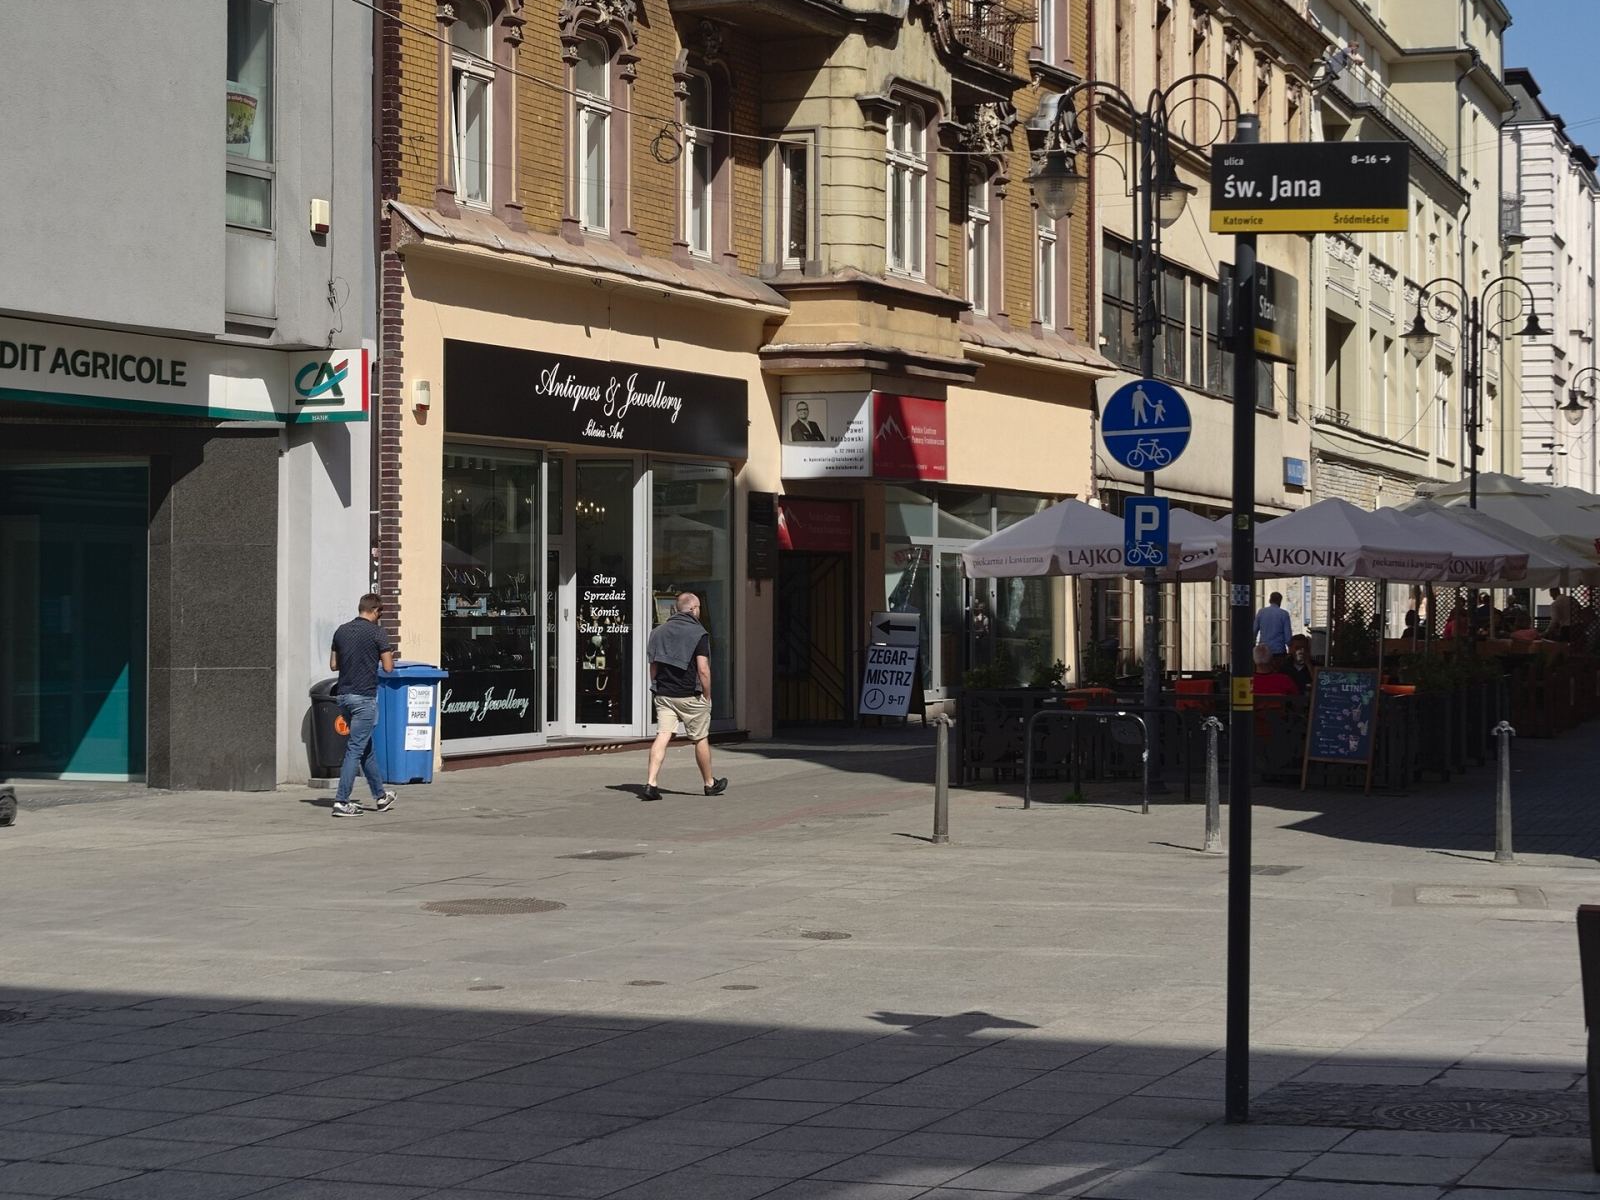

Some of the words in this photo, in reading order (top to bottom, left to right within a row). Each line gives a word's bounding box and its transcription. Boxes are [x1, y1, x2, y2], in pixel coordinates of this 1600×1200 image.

[1224, 156, 1244, 166] ulica
[1224, 174, 1263, 198] św.
[1270, 175, 1322, 201] Jana
[1223, 216, 1263, 225] Katowice
[1333, 212, 1389, 225] Śródmieście
[49, 347, 188, 387] AGRICOLE
[535, 362, 600, 412] Antiques
[604, 376, 621, 417] &
[617, 372, 683, 424] Jewellery
[582, 418, 606, 438] Silesia
[607, 421, 624, 440] Art
[1135, 505, 1160, 541] P
[1068, 549, 1122, 568] LAJKO
[1254, 548, 1346, 568] LAJKONIK
[1448, 559, 1489, 576] KONIK
[593, 573, 617, 587] Skup
[583, 590, 626, 603] Sprzedaż
[590, 606, 619, 617] Komis
[580, 623, 603, 636] Skup
[606, 623, 629, 633] złota
[869, 649, 915, 666] ZEGAR-
[866, 669, 912, 686] MISTRZ
[441, 688, 480, 722] Luxury
[477, 686, 529, 722] Jewellery
[887, 695, 906, 706] 9-17
